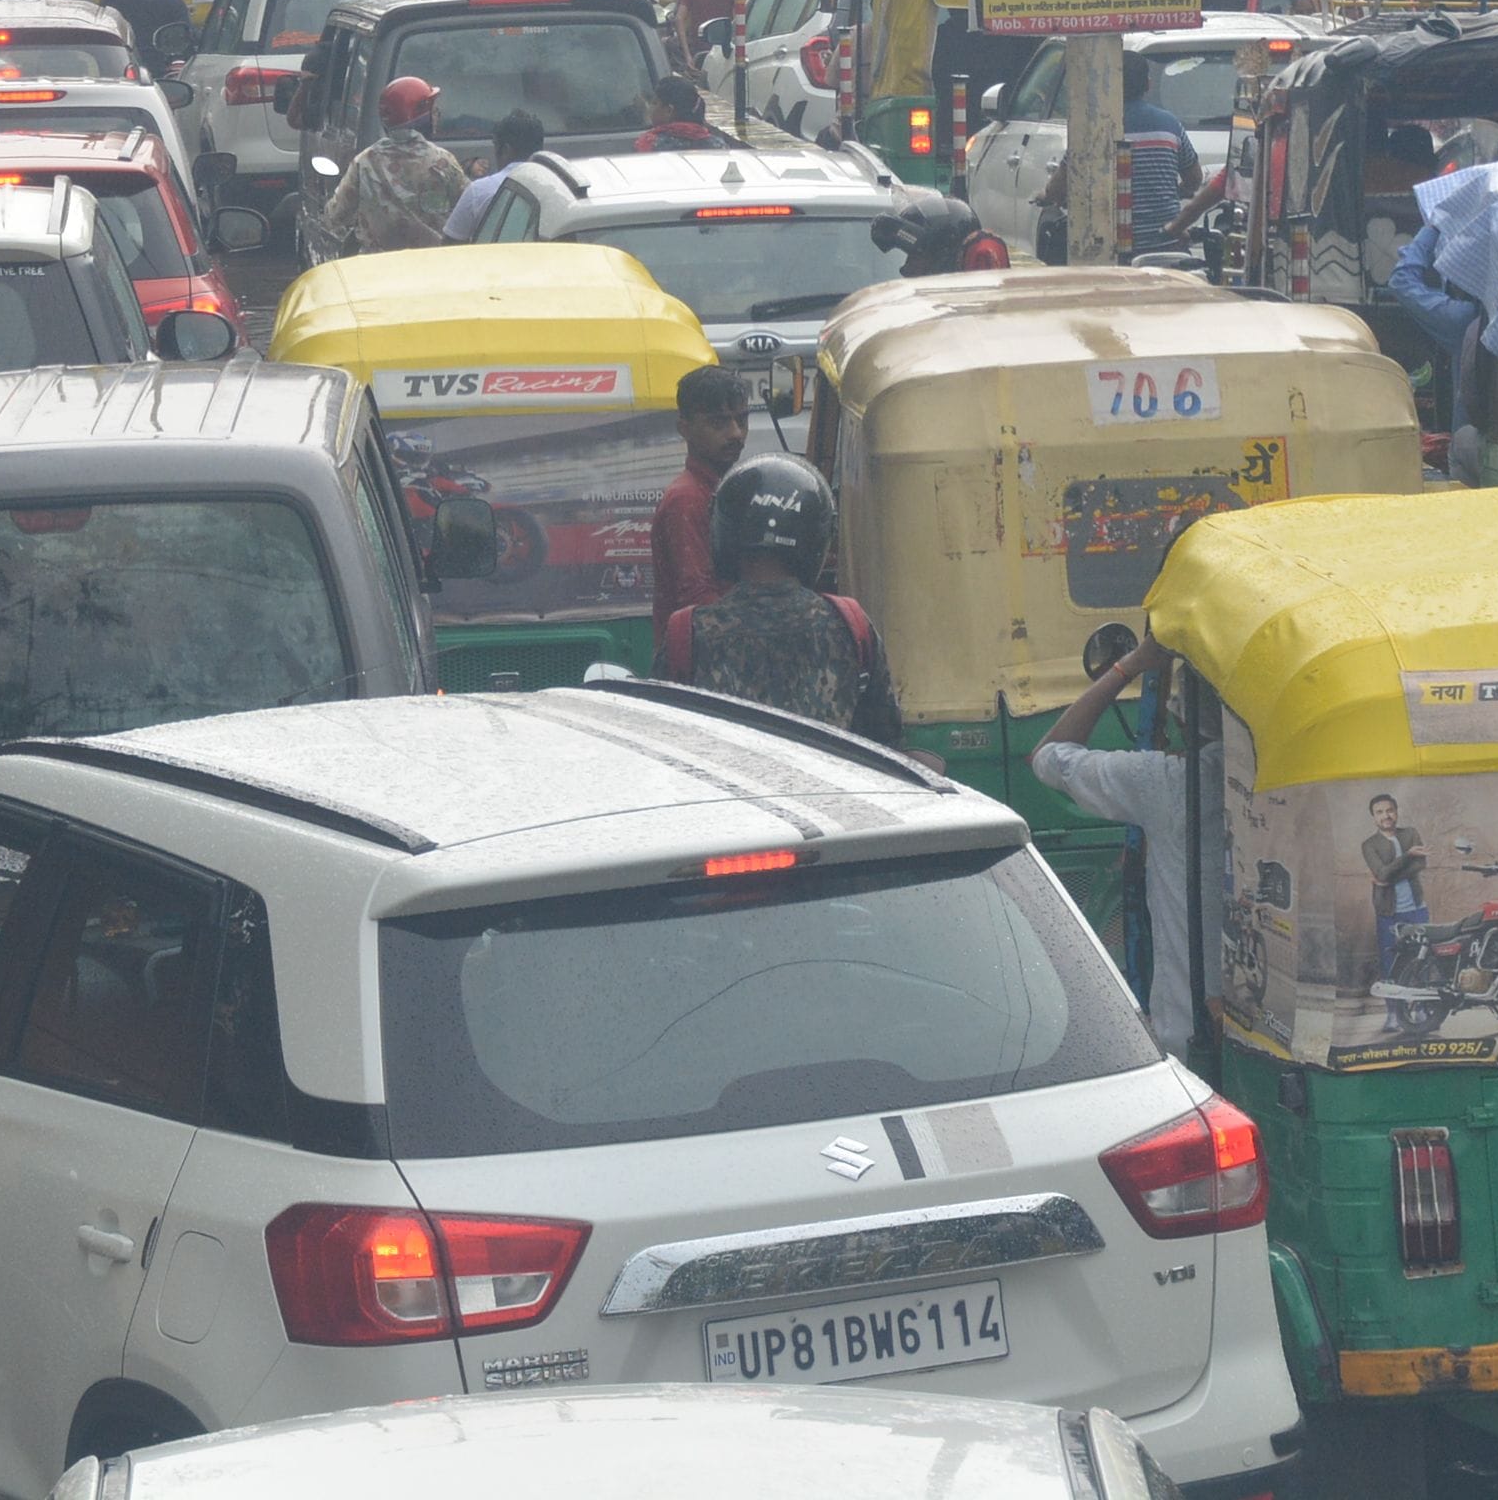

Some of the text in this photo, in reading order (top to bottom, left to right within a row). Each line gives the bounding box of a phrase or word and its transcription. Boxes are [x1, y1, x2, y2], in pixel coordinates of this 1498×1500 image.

[991, 18, 1026, 30] Mob.
[18, 267, 46, 276] FREE
[744, 336, 776, 350] KIA
[404, 370, 616, 397] TVS Racing
[1098, 367, 1203, 418] 706
[750, 490, 802, 513] NINJA
[1430, 684, 1464, 701] नया
[1154, 1264, 1196, 1286] VDi
[714, 1296, 1001, 1380] IND UP81BW6114
[483, 1348, 588, 1374] MARUTI
[485, 1363, 589, 1389] SUZUKI
